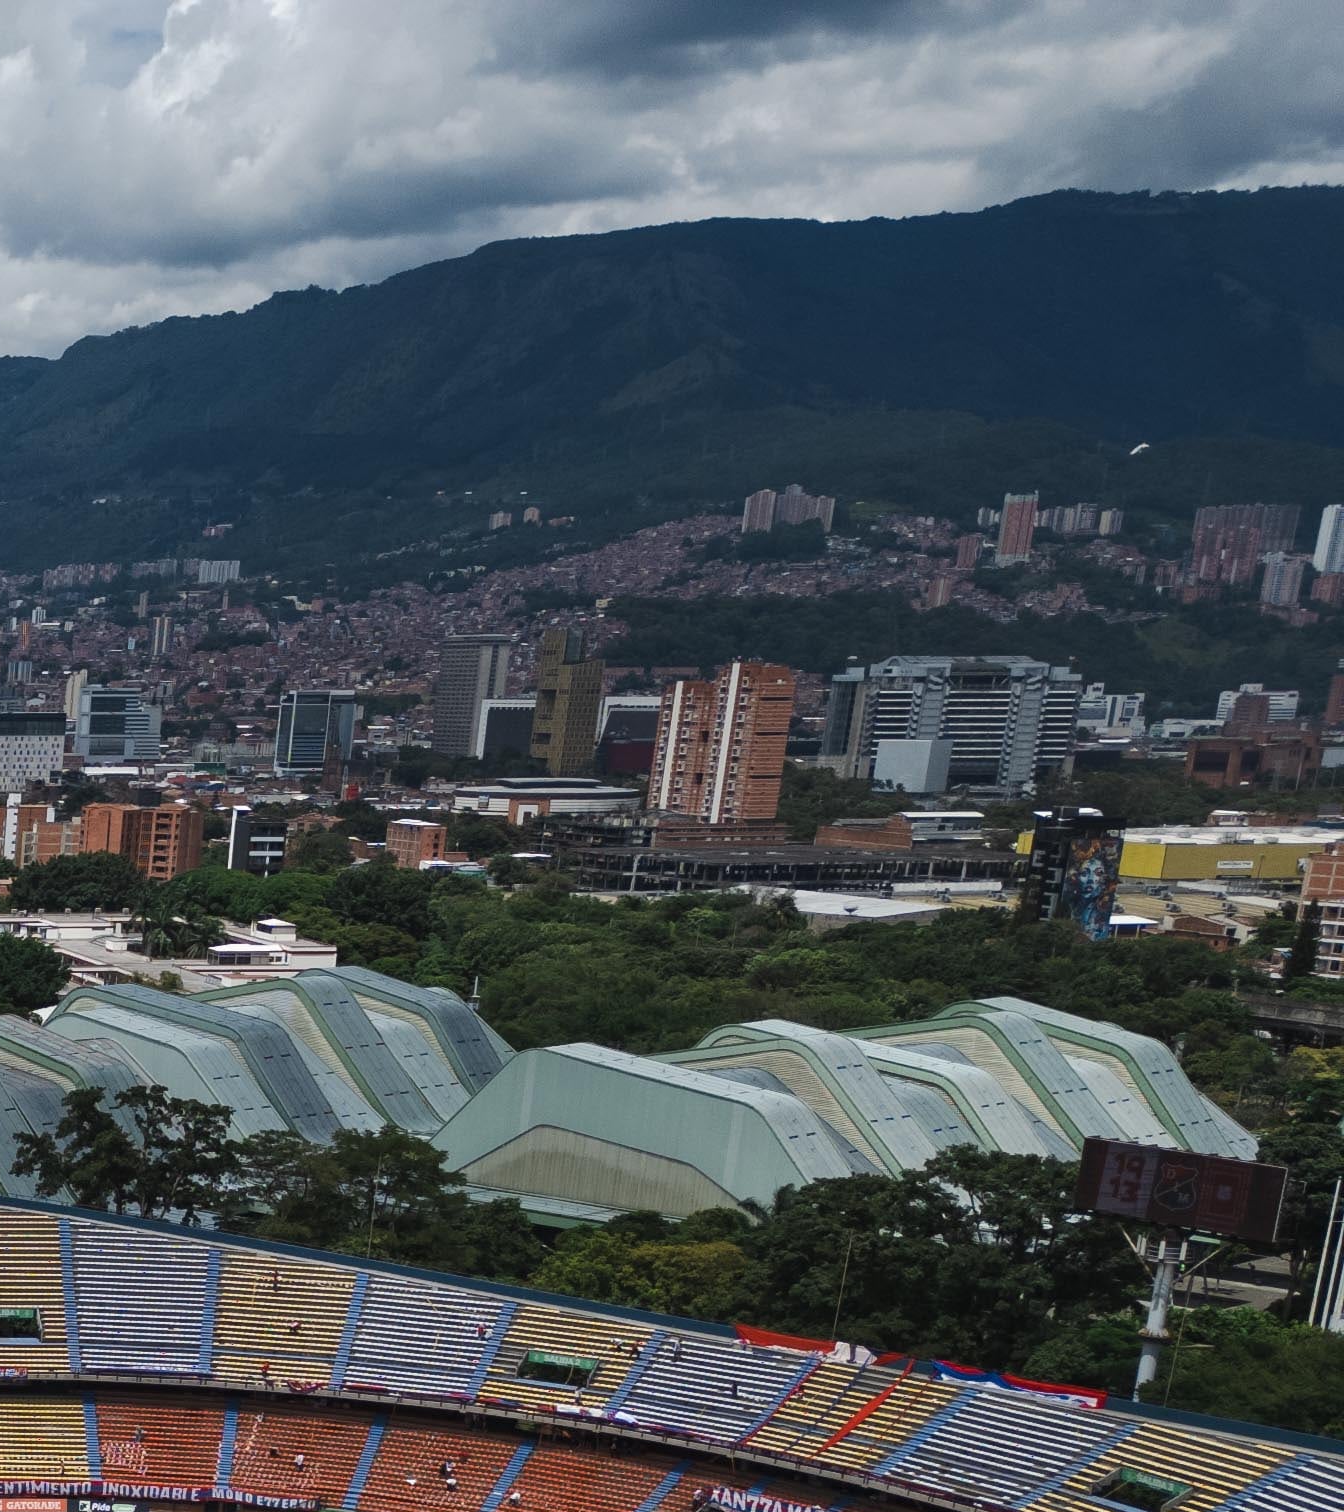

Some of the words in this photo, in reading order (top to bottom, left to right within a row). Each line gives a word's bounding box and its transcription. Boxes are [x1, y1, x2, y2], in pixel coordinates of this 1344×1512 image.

[543, 1353, 572, 1366] SALIDA
[102, 1482, 201, 1502] INOXIDABLE
[6, 1501, 62, 1511] GATORADE
